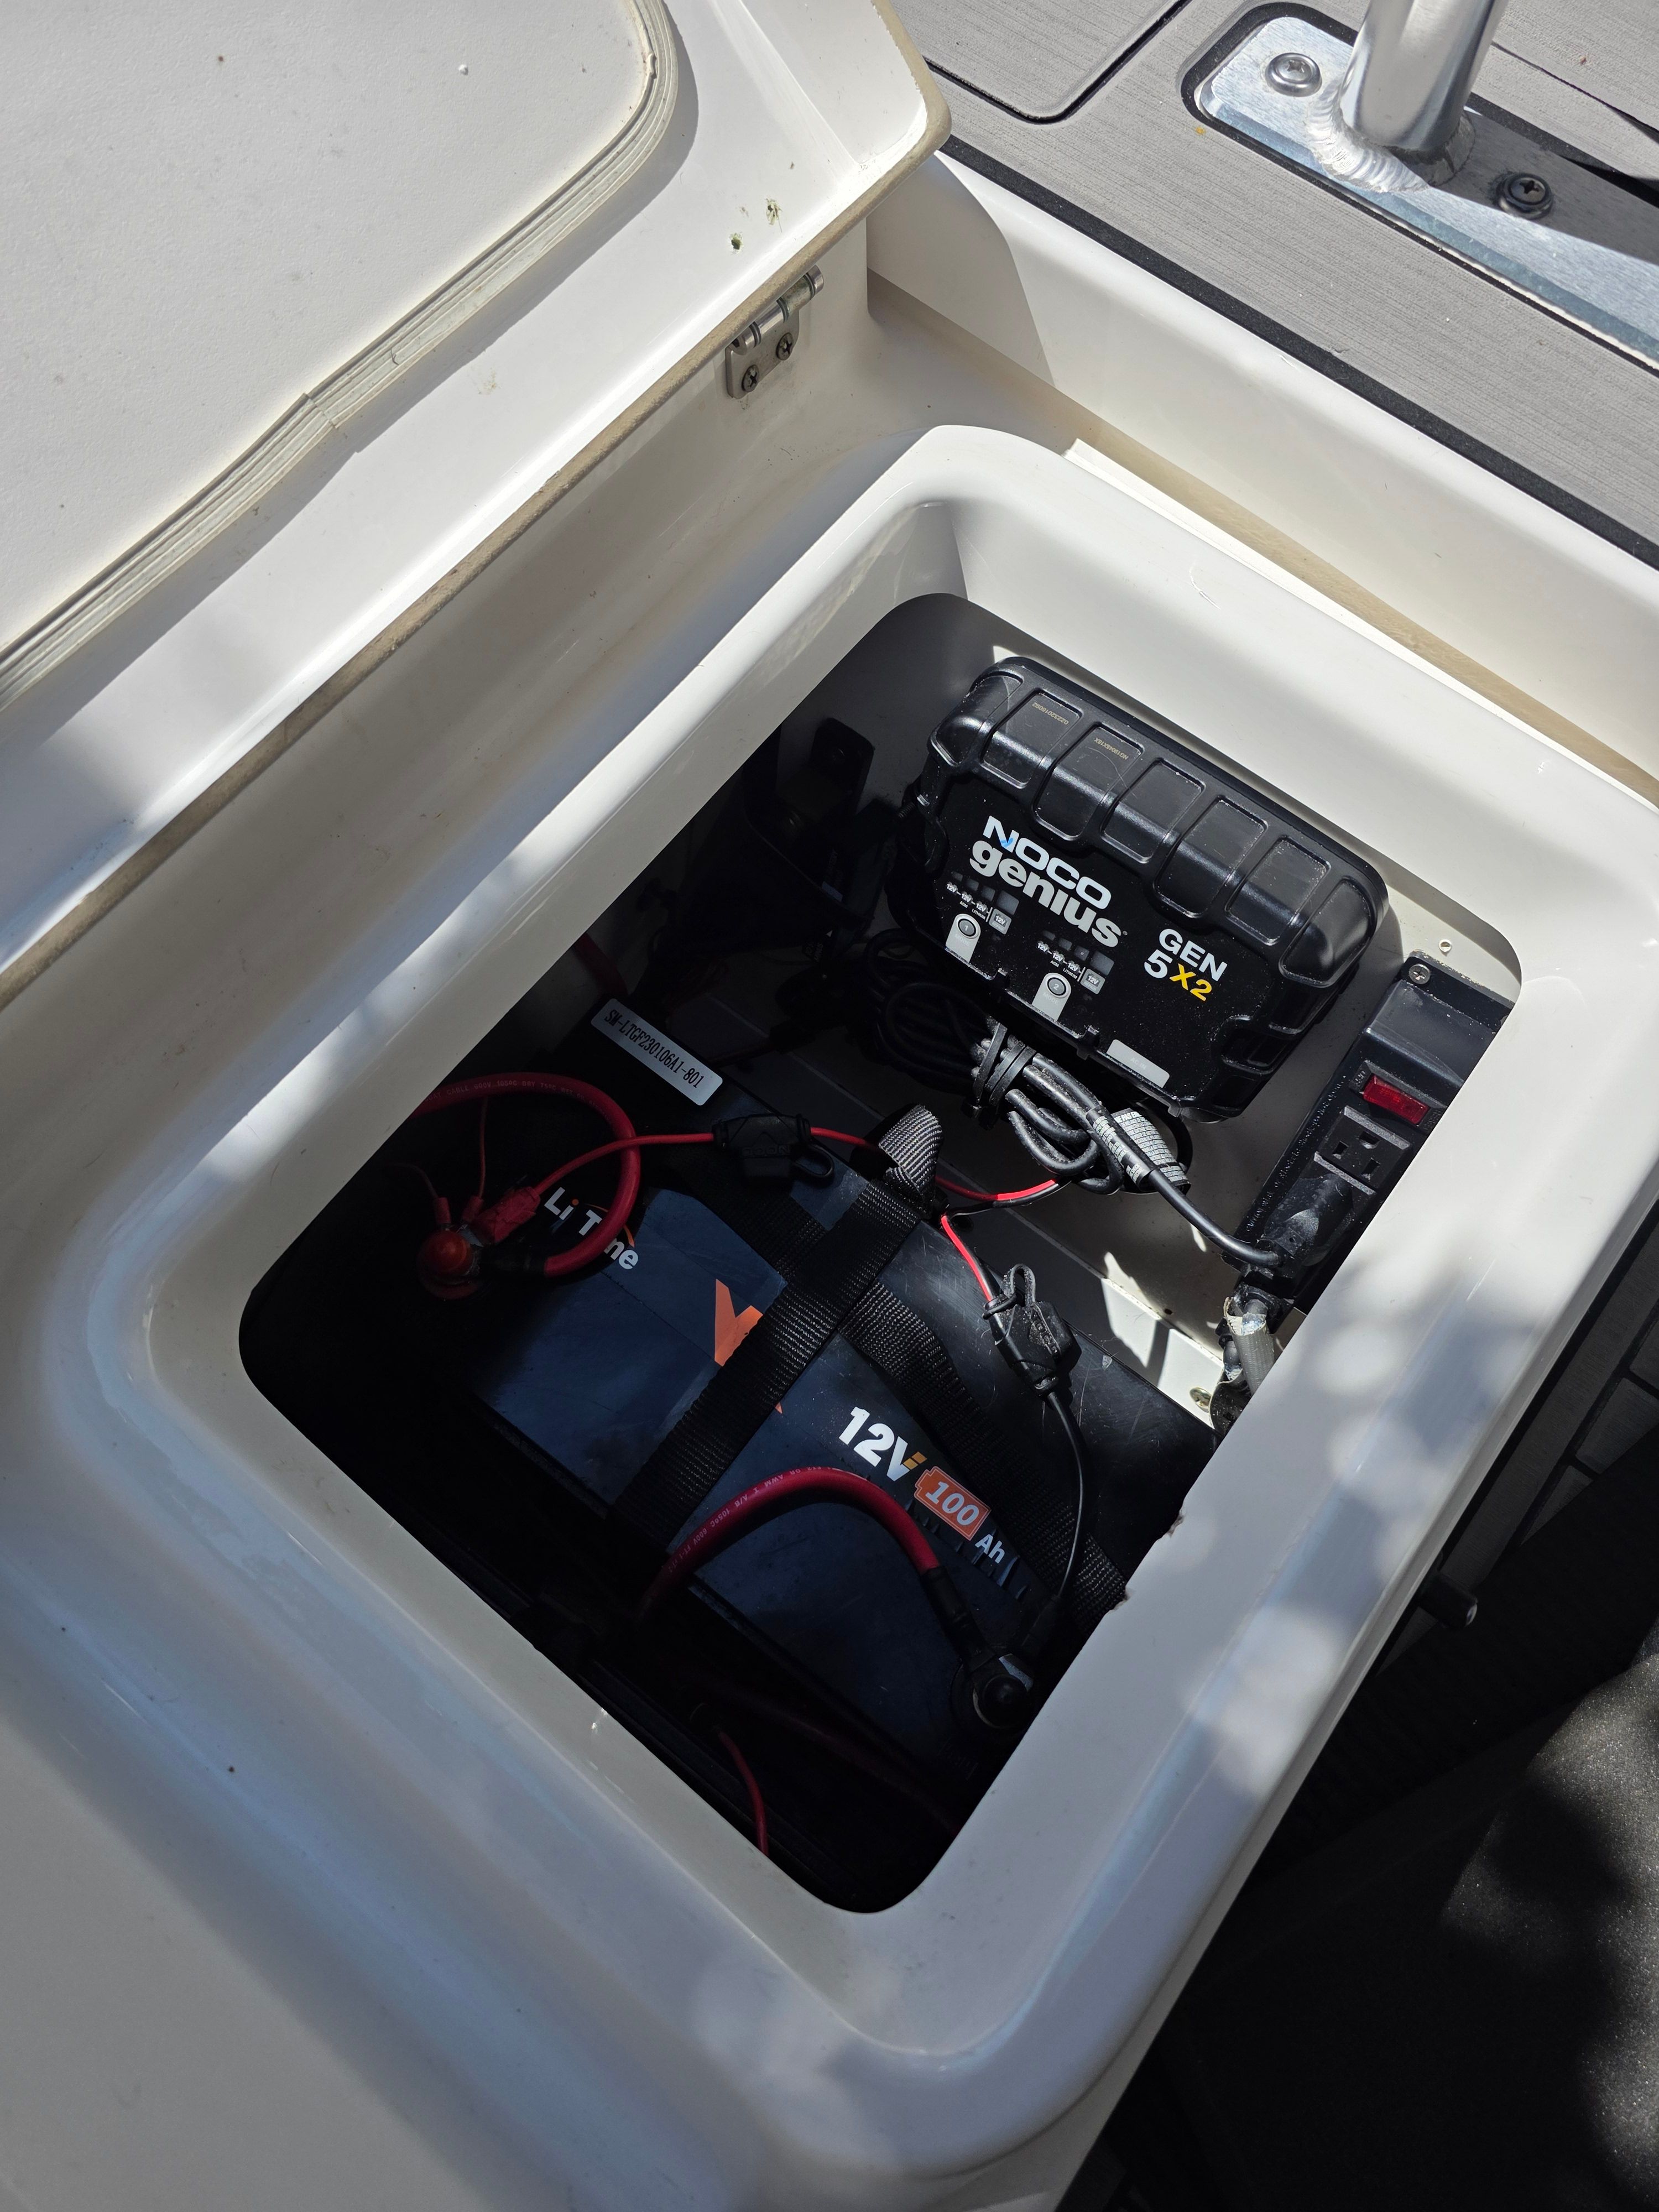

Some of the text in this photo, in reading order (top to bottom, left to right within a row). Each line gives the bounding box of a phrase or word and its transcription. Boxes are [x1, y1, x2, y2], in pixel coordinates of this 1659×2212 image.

[983, 816, 1112, 910] NOCO
[947, 884, 987, 912] 12V 12V 12V
[969, 841, 1121, 947] genius
[995, 915, 1006, 925] 12V
[1037, 943, 1078, 972] 12V 12V 12V
[1159, 928, 1228, 981] GEN
[1088, 975, 1099, 985] 12V
[447, 1085, 469, 1095] CABLE
[839, 1406, 927, 1482] 12V
[764, 1474, 784, 1487] AWM
[734, 1494, 748, 1507] A/B
[925, 1481, 979, 1527] 100
[693, 1528, 707, 1545] 600V
[975, 1534, 1005, 1564] Ah
